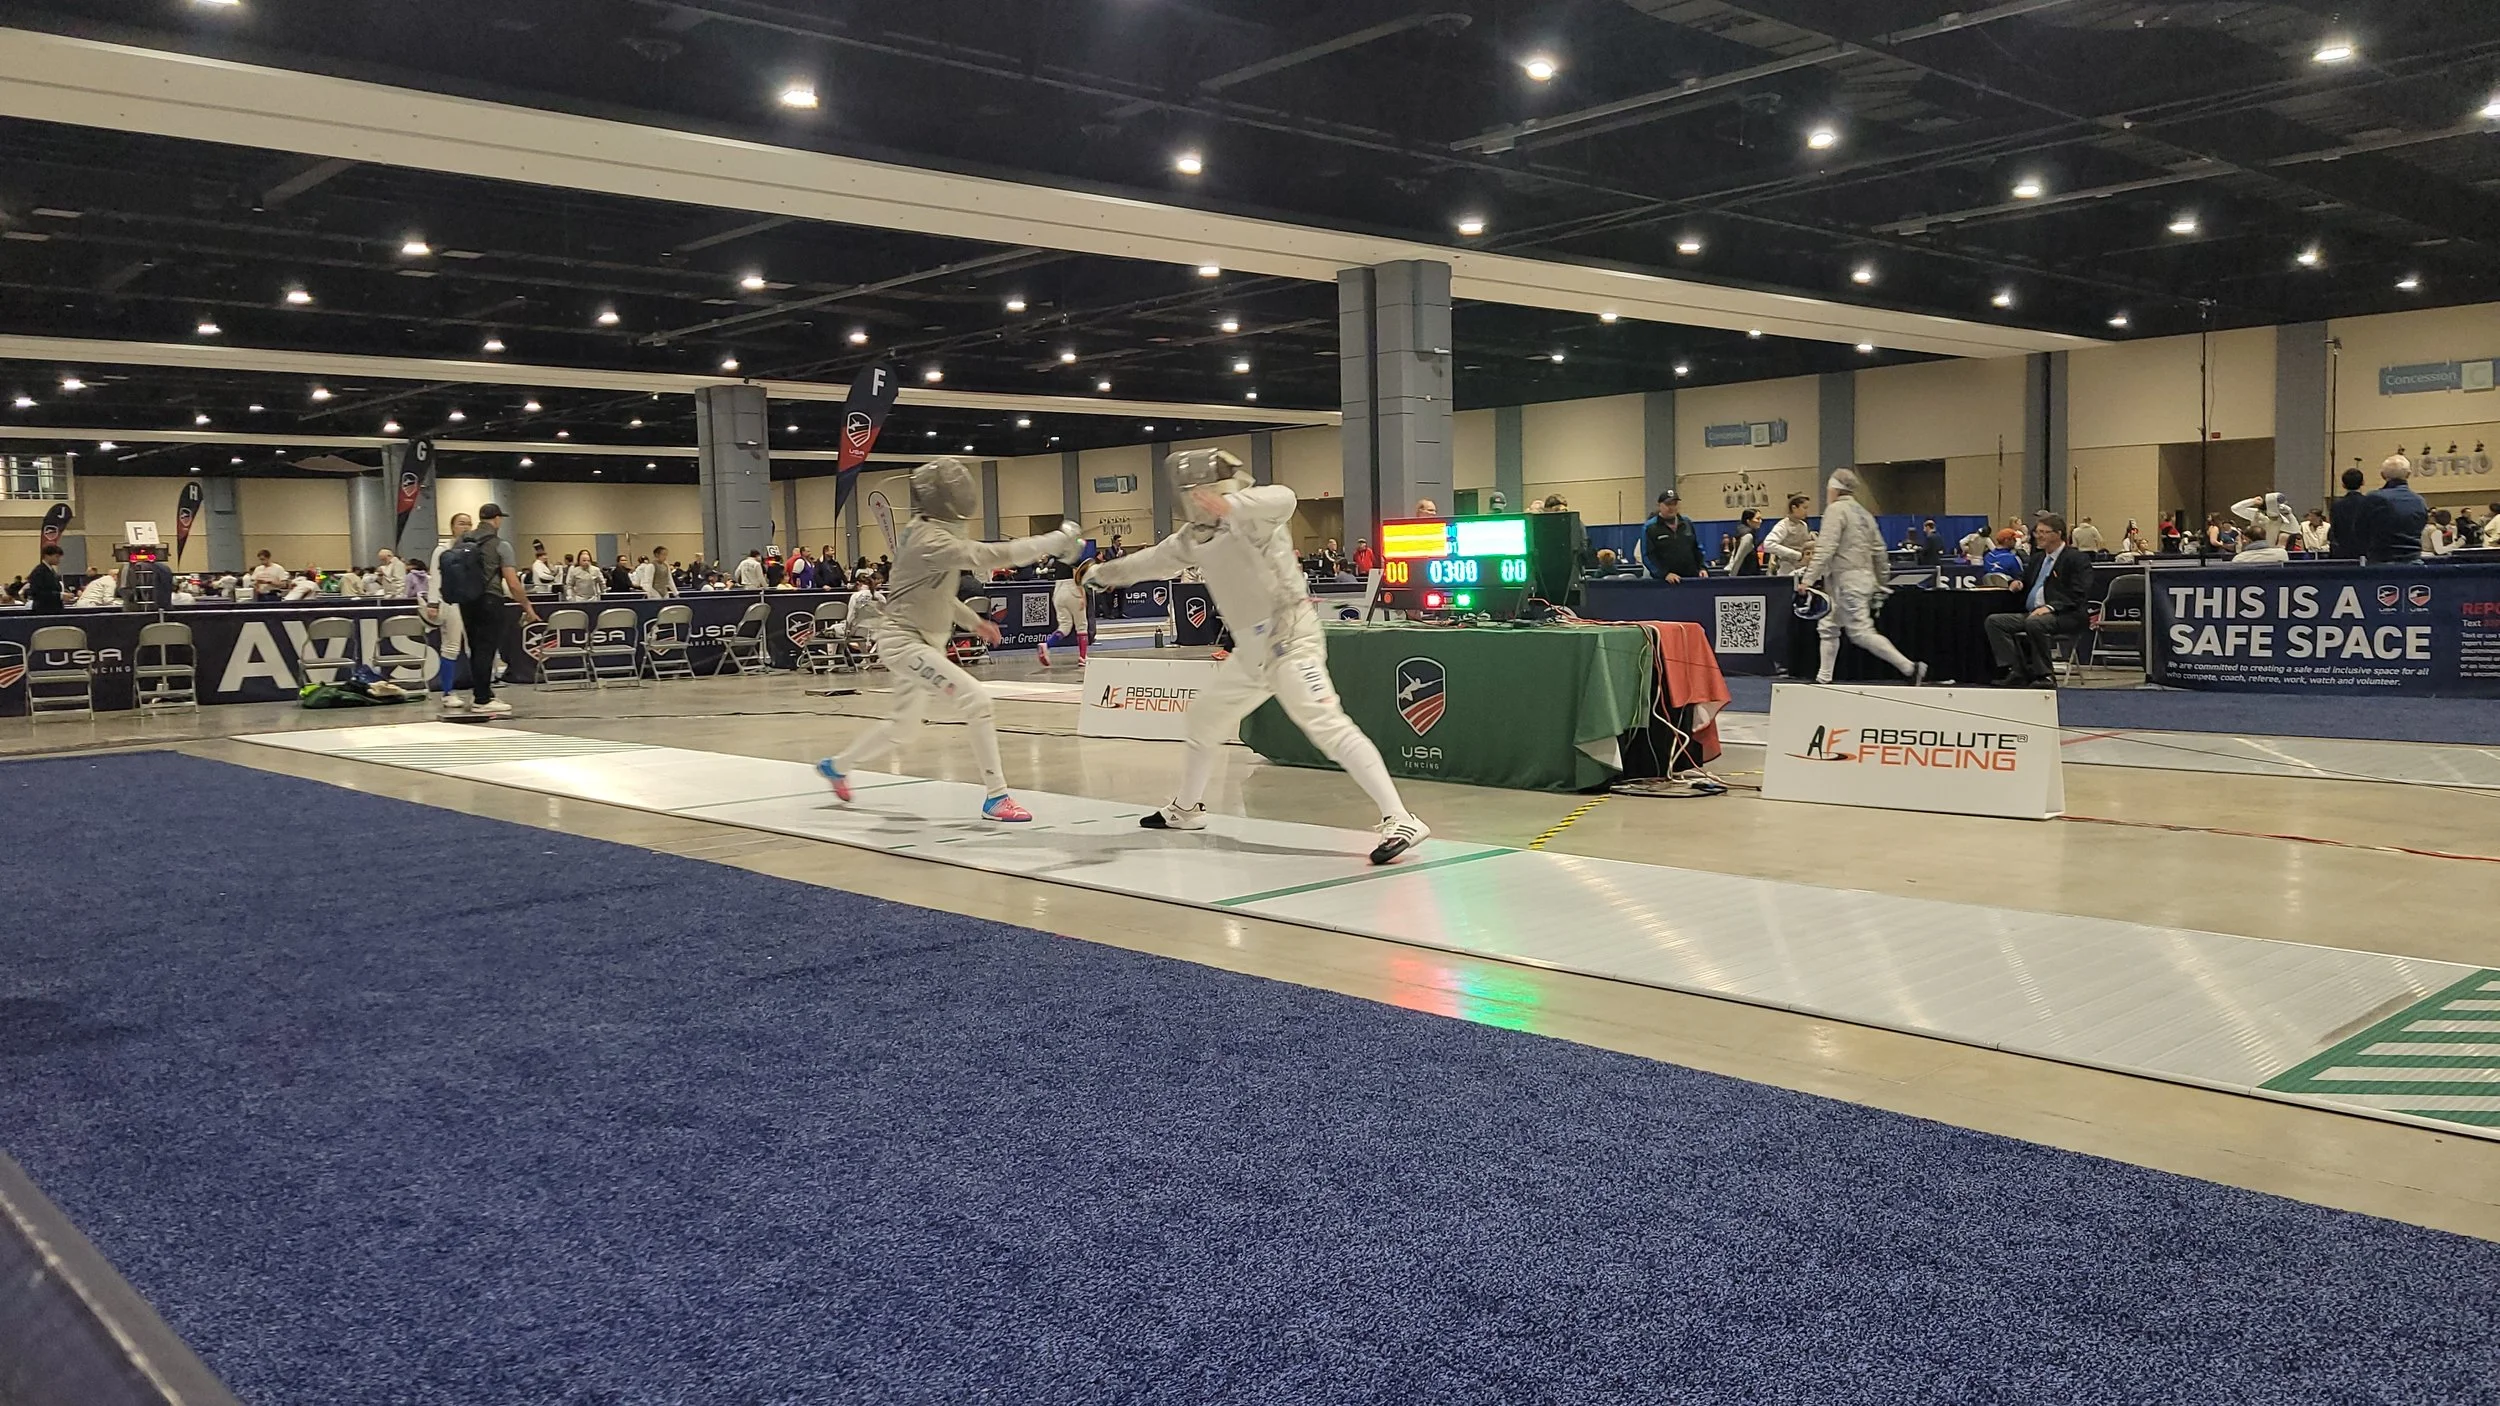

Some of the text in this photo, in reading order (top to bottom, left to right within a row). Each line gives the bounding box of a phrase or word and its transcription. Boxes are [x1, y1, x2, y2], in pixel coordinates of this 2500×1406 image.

[872, 368, 887, 396] F
[2386, 371, 2457, 386] Concession
[417, 441, 428, 461] G
[2412, 453, 2493, 477] ISTRO
[189, 485, 198, 500] H
[57, 506, 66, 518] J
[133, 527, 144, 541] F
[1385, 561, 1409, 584] 00
[1501, 558, 1527, 583] 00
[1125, 592, 1148, 600] USA
[2168, 585, 2365, 619] THIS IS A
[2113, 608, 2141, 618] US
[2462, 619, 2482, 627] Text
[571, 630, 626, 645] USA
[690, 624, 738, 638] USA
[999, 633, 1017, 645] heir
[2169, 624, 2432, 660] SAFE SPACE
[45, 648, 123, 666] USA
[217, 618, 441, 692] AVIS
[2194, 663, 2239, 671] committed
[2240, 664, 2249, 672] to
[2250, 665, 2285, 674] creating
[2293, 665, 2312, 673] safe
[2314, 666, 2331, 674] and
[2332, 666, 2372, 675] inclusive
[2373, 668, 2400, 676] space
[2401, 667, 2415, 676] for
[2416, 668, 2430, 676] all
[2183, 673, 2218, 682] compete,
[2220, 673, 2246, 683] coach,
[2248, 675, 2282, 684] referee,
[2283, 675, 2307, 685] work,
[2309, 676, 2336, 685] watch
[2337, 677, 2355, 685] and
[2356, 677, 2402, 686] volunteer.
[1126, 686, 1200, 700] ABSOLUTE
[1401, 745, 1443, 760] USA
[1858, 744, 2017, 772] FENCING
[1405, 761, 1440, 770] FENCING
